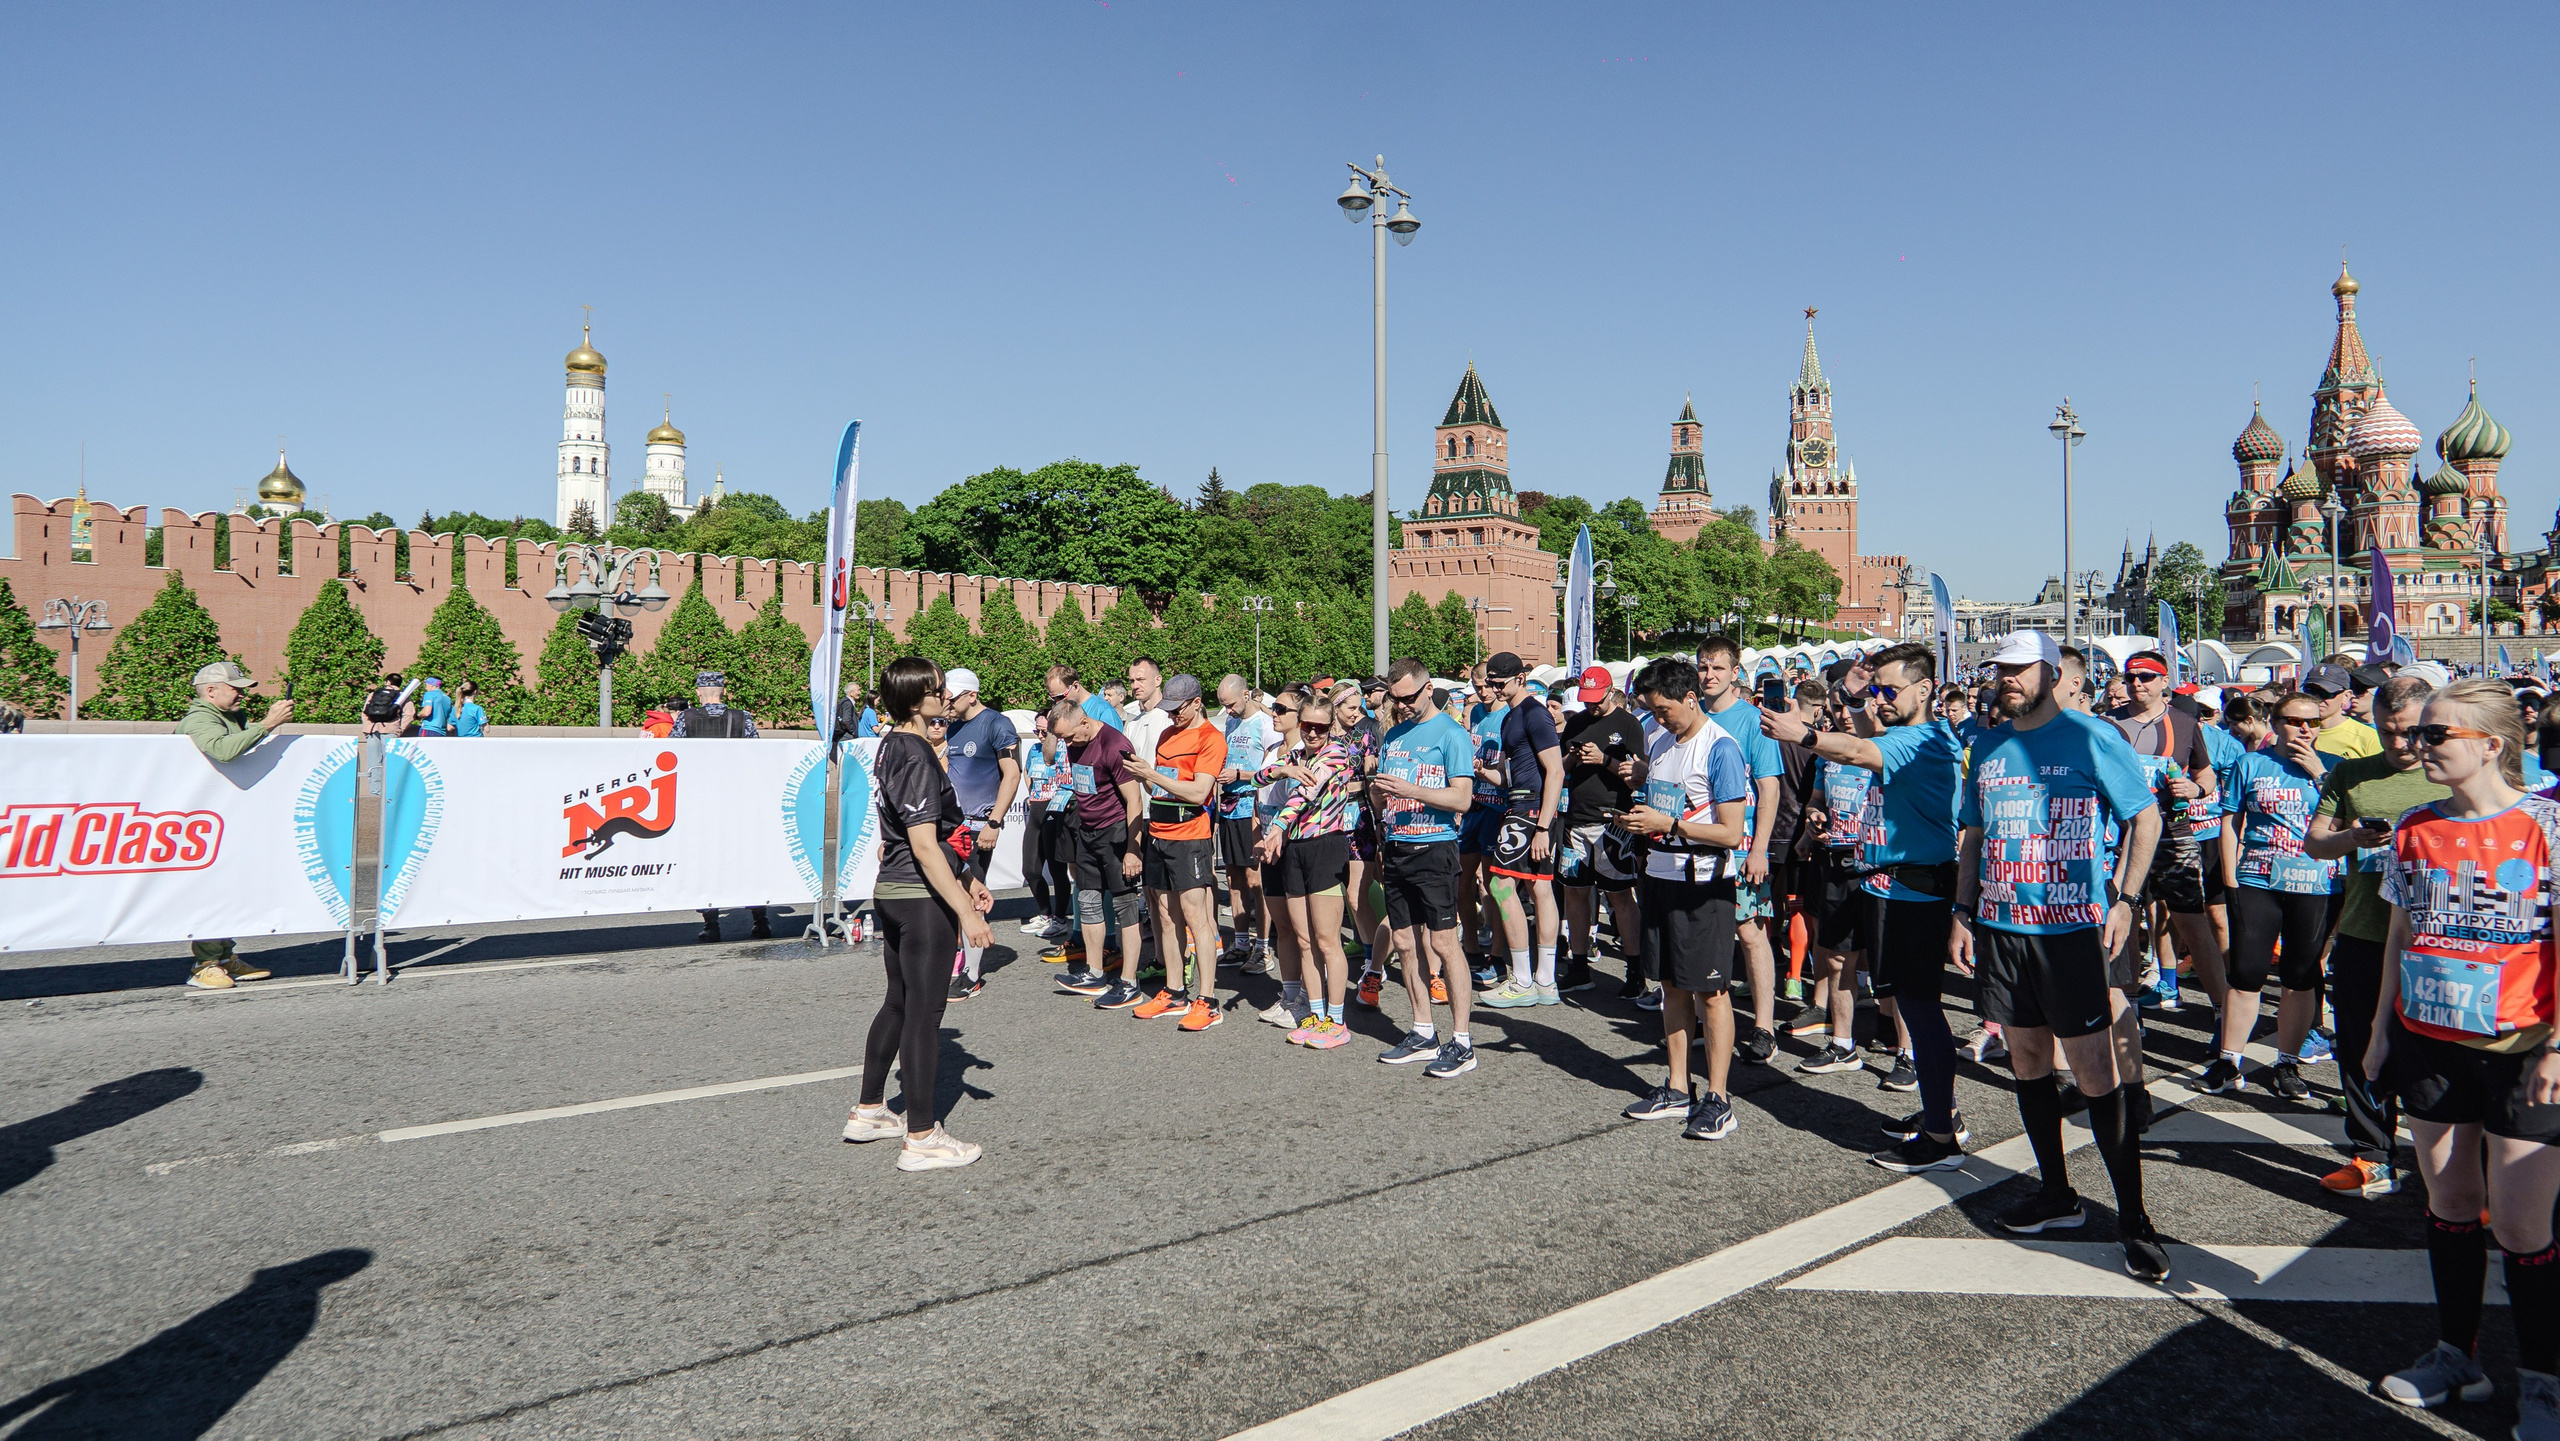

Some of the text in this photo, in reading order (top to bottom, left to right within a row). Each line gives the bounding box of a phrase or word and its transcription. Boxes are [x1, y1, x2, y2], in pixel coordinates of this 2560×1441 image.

[564, 768, 652, 804] ENERGY
[1831, 785, 1857, 801] 42927
[2256, 788, 2302, 802] #МЕЧТА
[1653, 792, 1675, 810] 42621
[1994, 800, 2034, 818] 41097
[1411, 813, 1435, 826] 2024
[1997, 819, 2029, 836] 21.1KM
[69, 812, 213, 866] Class
[560, 867, 583, 879] HIT
[585, 865, 628, 878] MUSIC
[631, 864, 664, 876] ONLY
[2283, 867, 2317, 882] 43610
[2047, 883, 2088, 904] 2024
[2285, 881, 2313, 893] 21.1KM
[2009, 903, 2104, 925] #ЕДИНСТВО
[2446, 926, 2531, 944] БЕГОВУЮ
[2414, 976, 2474, 1008] 42197
[2419, 1003, 2464, 1030] 21.1KM
